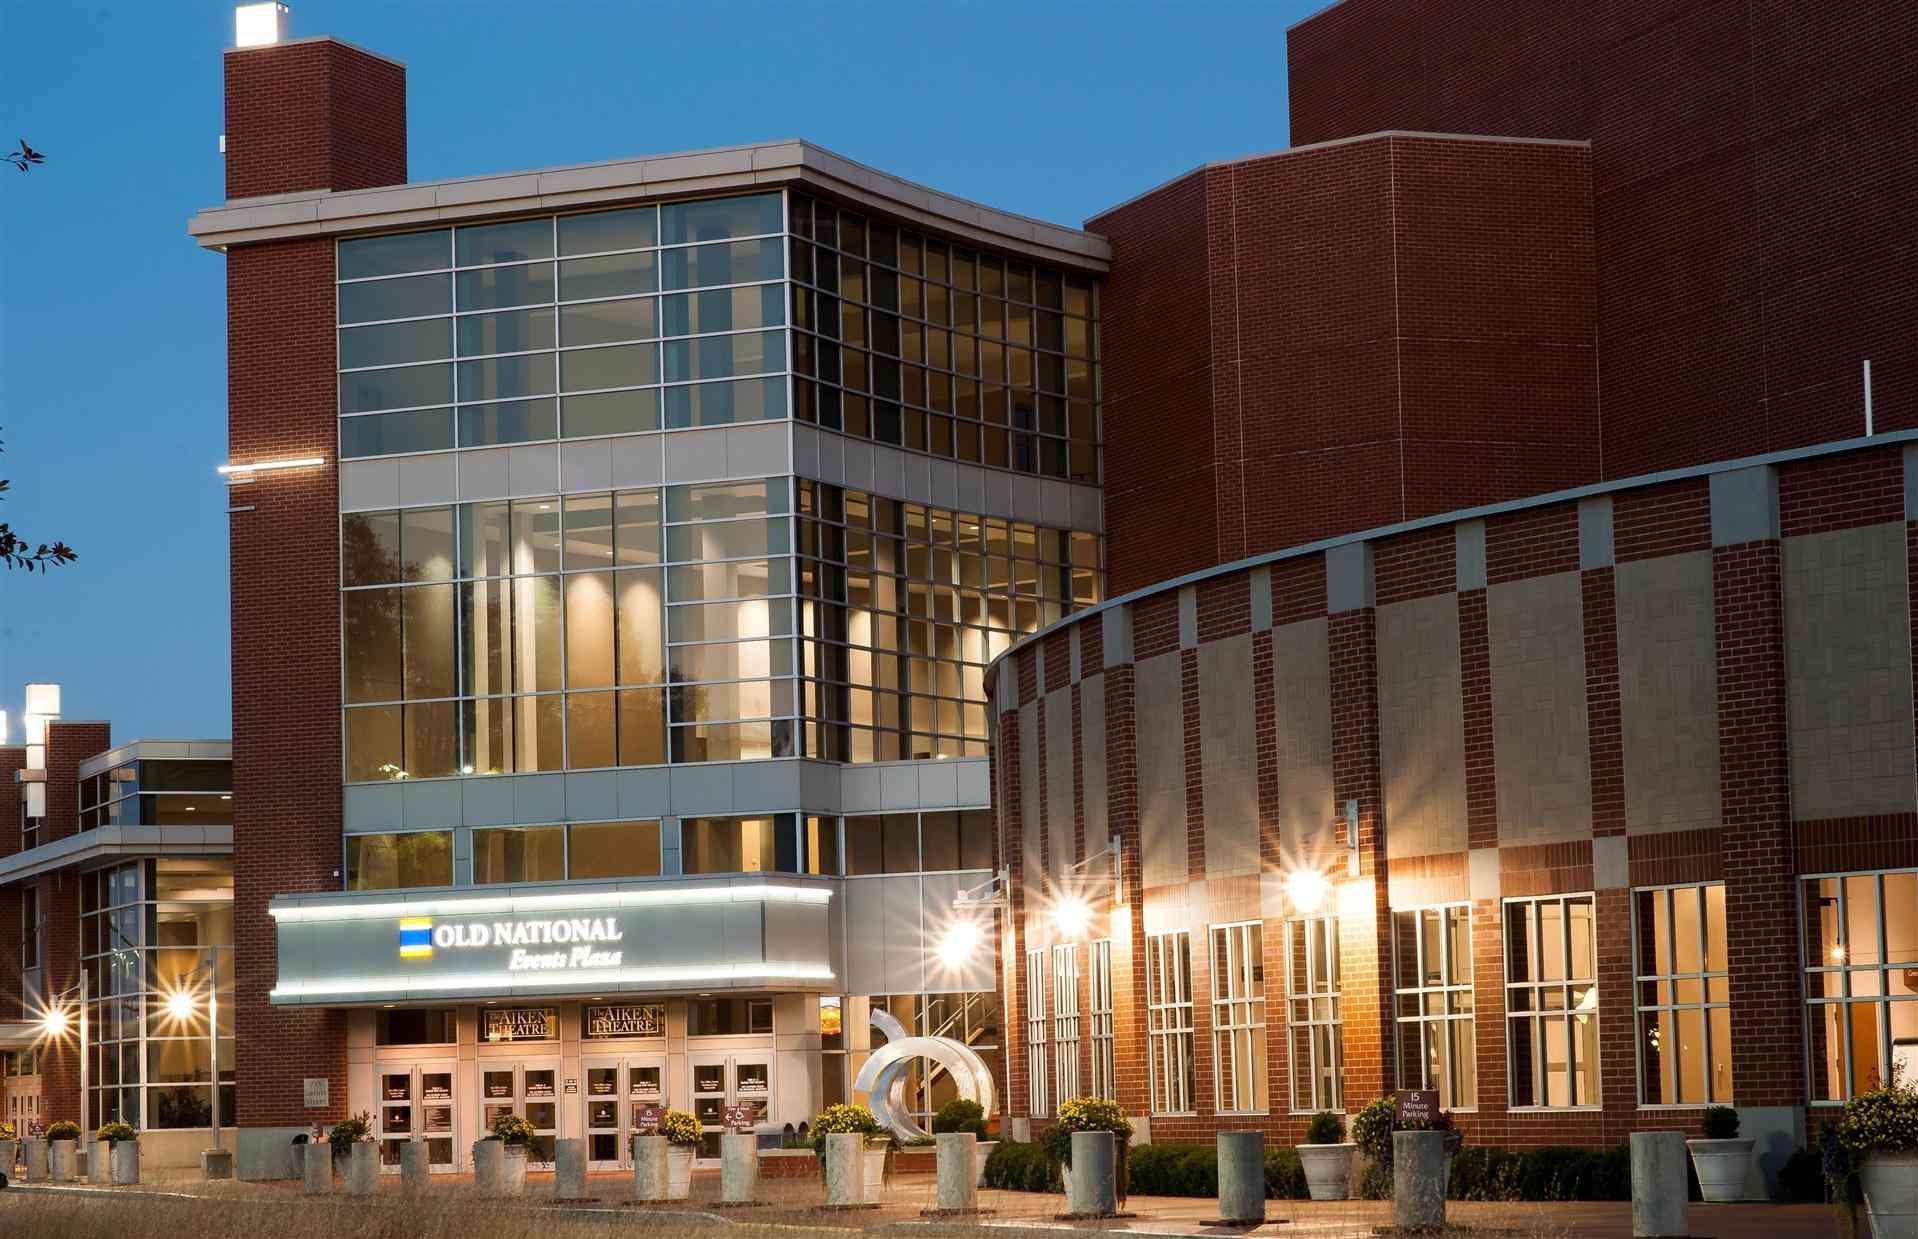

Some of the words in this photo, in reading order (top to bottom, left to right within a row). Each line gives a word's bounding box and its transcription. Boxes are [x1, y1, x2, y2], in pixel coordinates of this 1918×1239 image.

[435, 924, 490, 947] OLD
[493, 918, 623, 944] NATIONAL
[509, 949, 567, 969] Events
[569, 945, 622, 968] Plaza
[499, 1010, 547, 1024] AIKEN
[604, 1006, 654, 1021] AIKEN
[489, 1023, 549, 1037] THEATRE
[592, 1020, 655, 1032] THEATRE
[1411, 1092, 1420, 1101] 15
[1403, 1102, 1428, 1110] Minute
[1402, 1110, 1429, 1119] Parking
